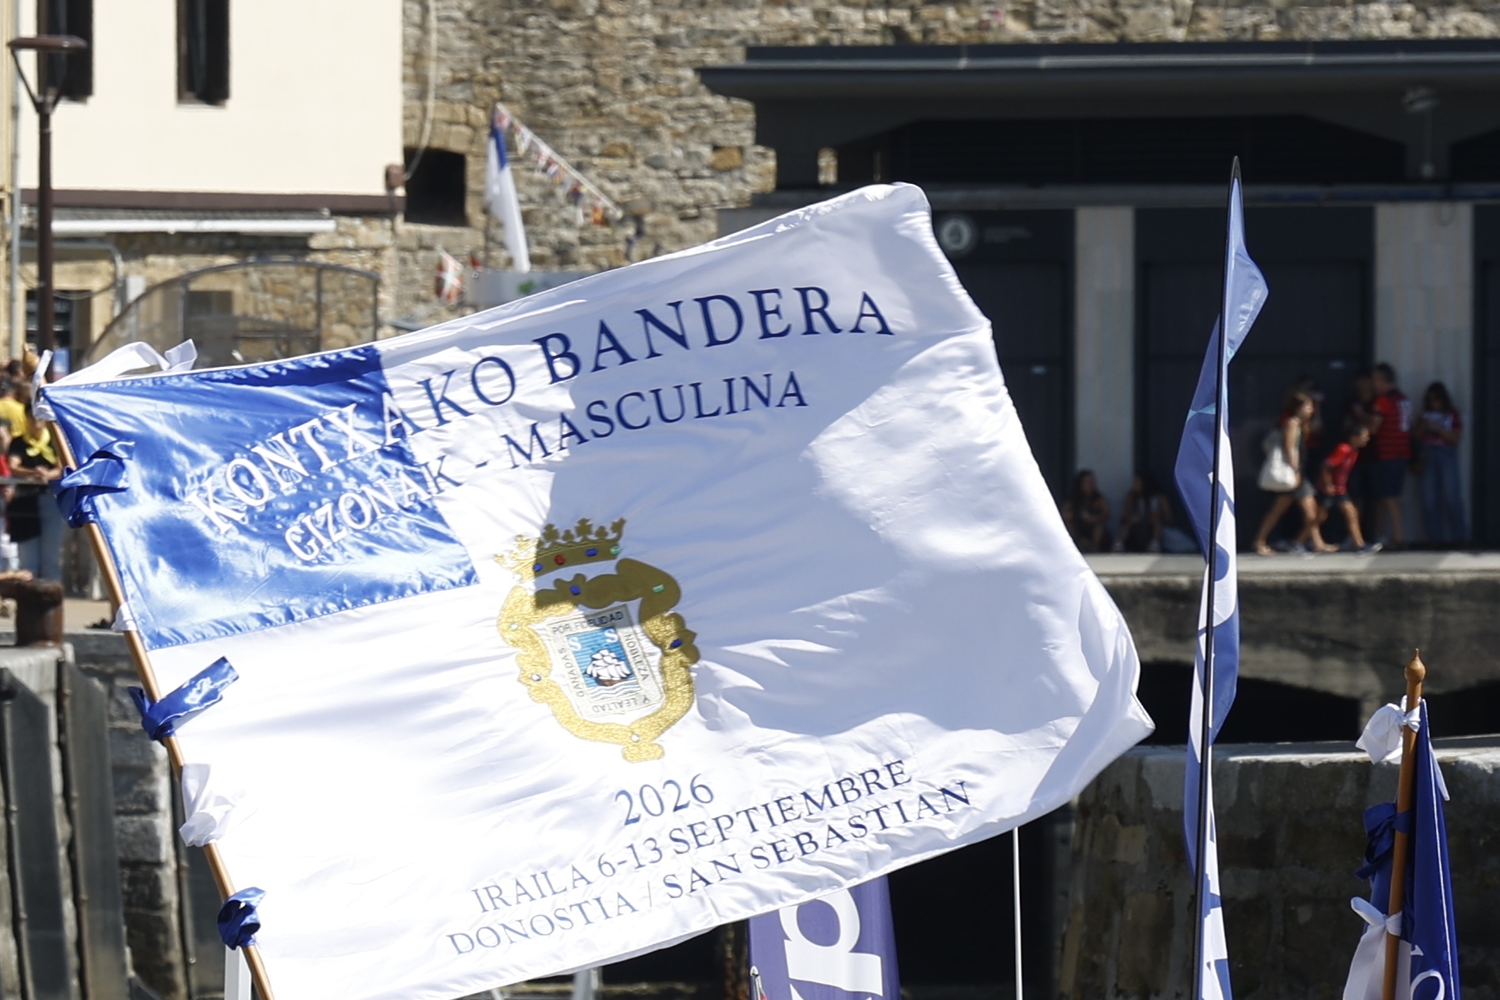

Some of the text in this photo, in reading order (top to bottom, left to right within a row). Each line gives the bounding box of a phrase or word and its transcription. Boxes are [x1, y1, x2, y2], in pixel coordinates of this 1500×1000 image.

[187, 285, 895, 535] KONTXAKO BANDERA
[284, 455, 464, 562] GIZONAK
[500, 370, 808, 469] MASCULINA
[552, 620, 572, 635] POR
[623, 632, 649, 681] NOBLEZA
[471, 760, 912, 913] IRAILA 6-13 SEPTIEMBRE
[614, 774, 714, 826] 2026
[446, 892, 639, 955] DONOSTIA
[662, 853, 742, 899] SAN
